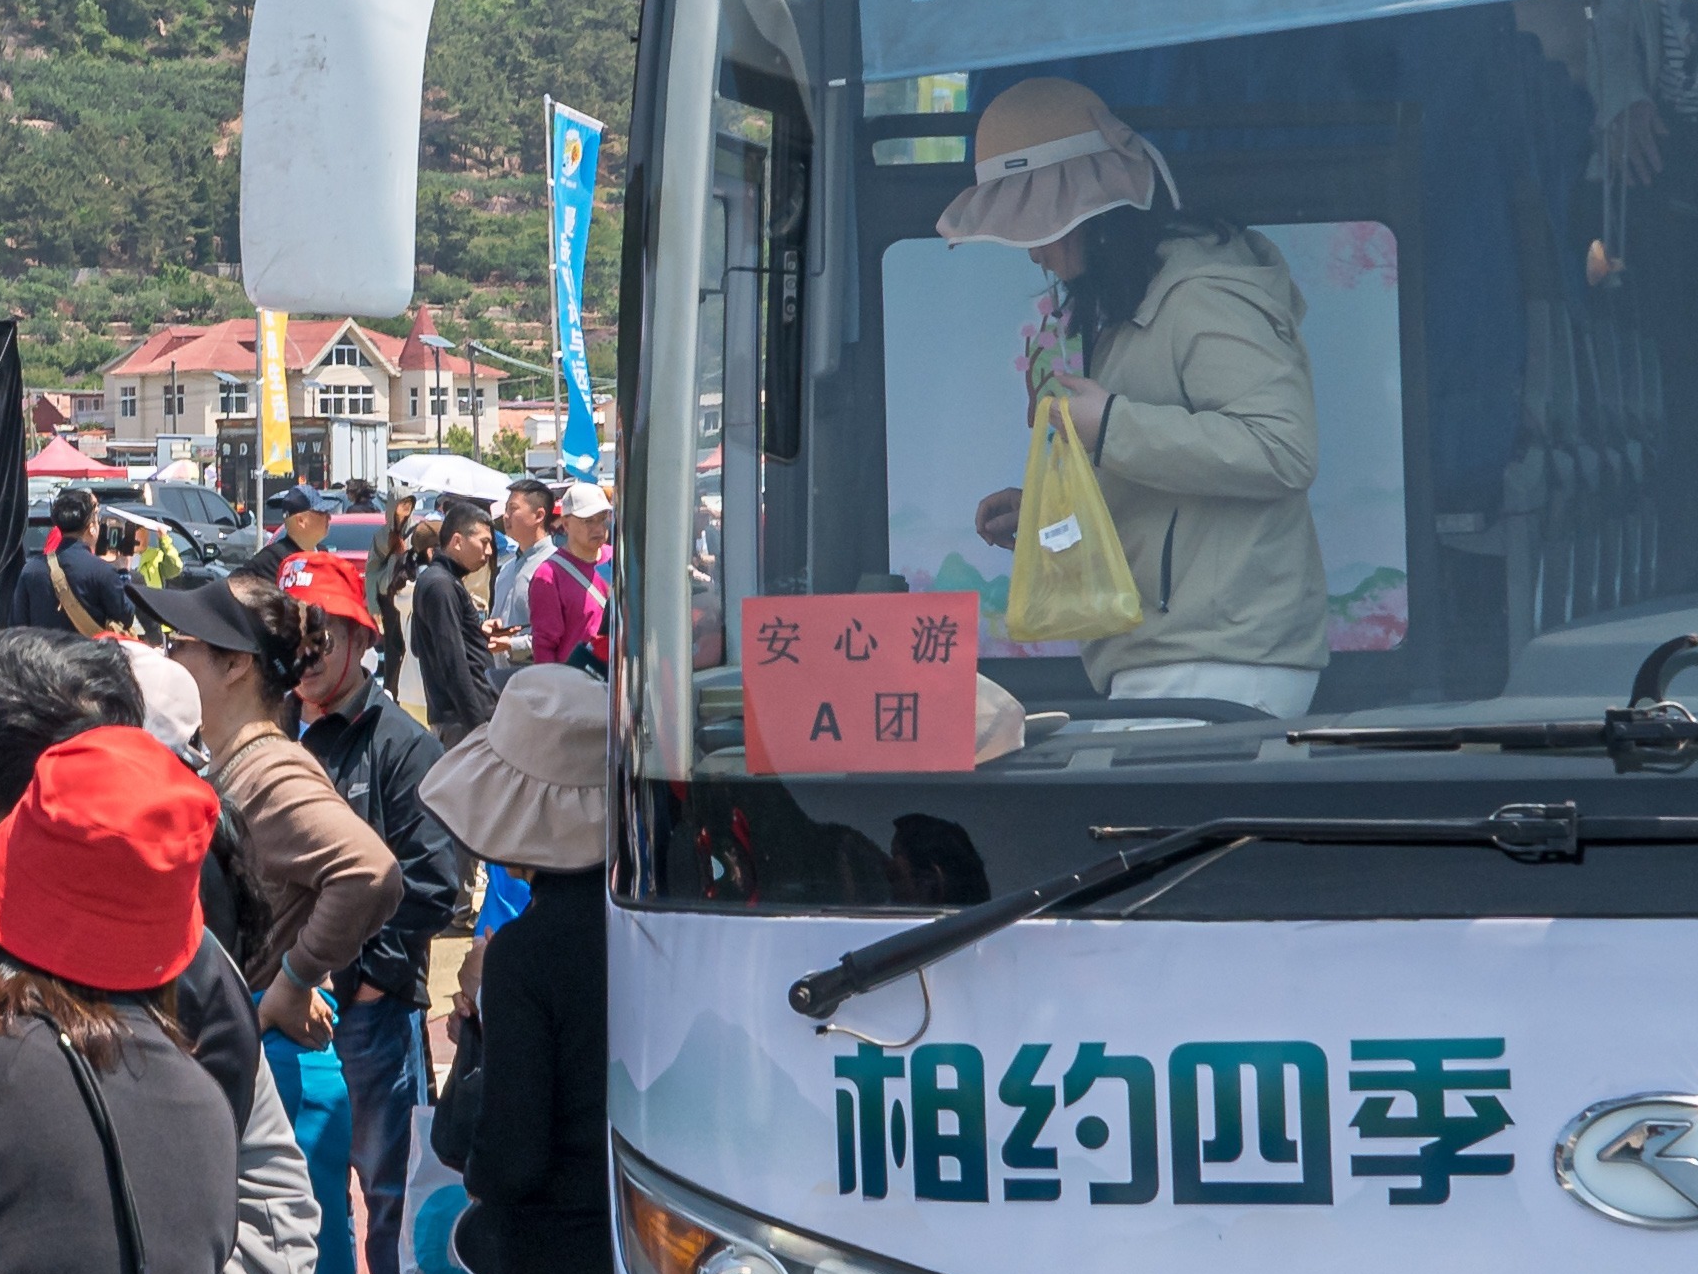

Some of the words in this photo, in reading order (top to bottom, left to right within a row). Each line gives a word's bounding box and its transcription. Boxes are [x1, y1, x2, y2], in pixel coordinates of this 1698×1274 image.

[756, 614, 959, 666] 安心游
[809, 702, 842, 742] A
[874, 692, 919, 742] 团
[834, 1038, 1516, 1206] 相约四季
